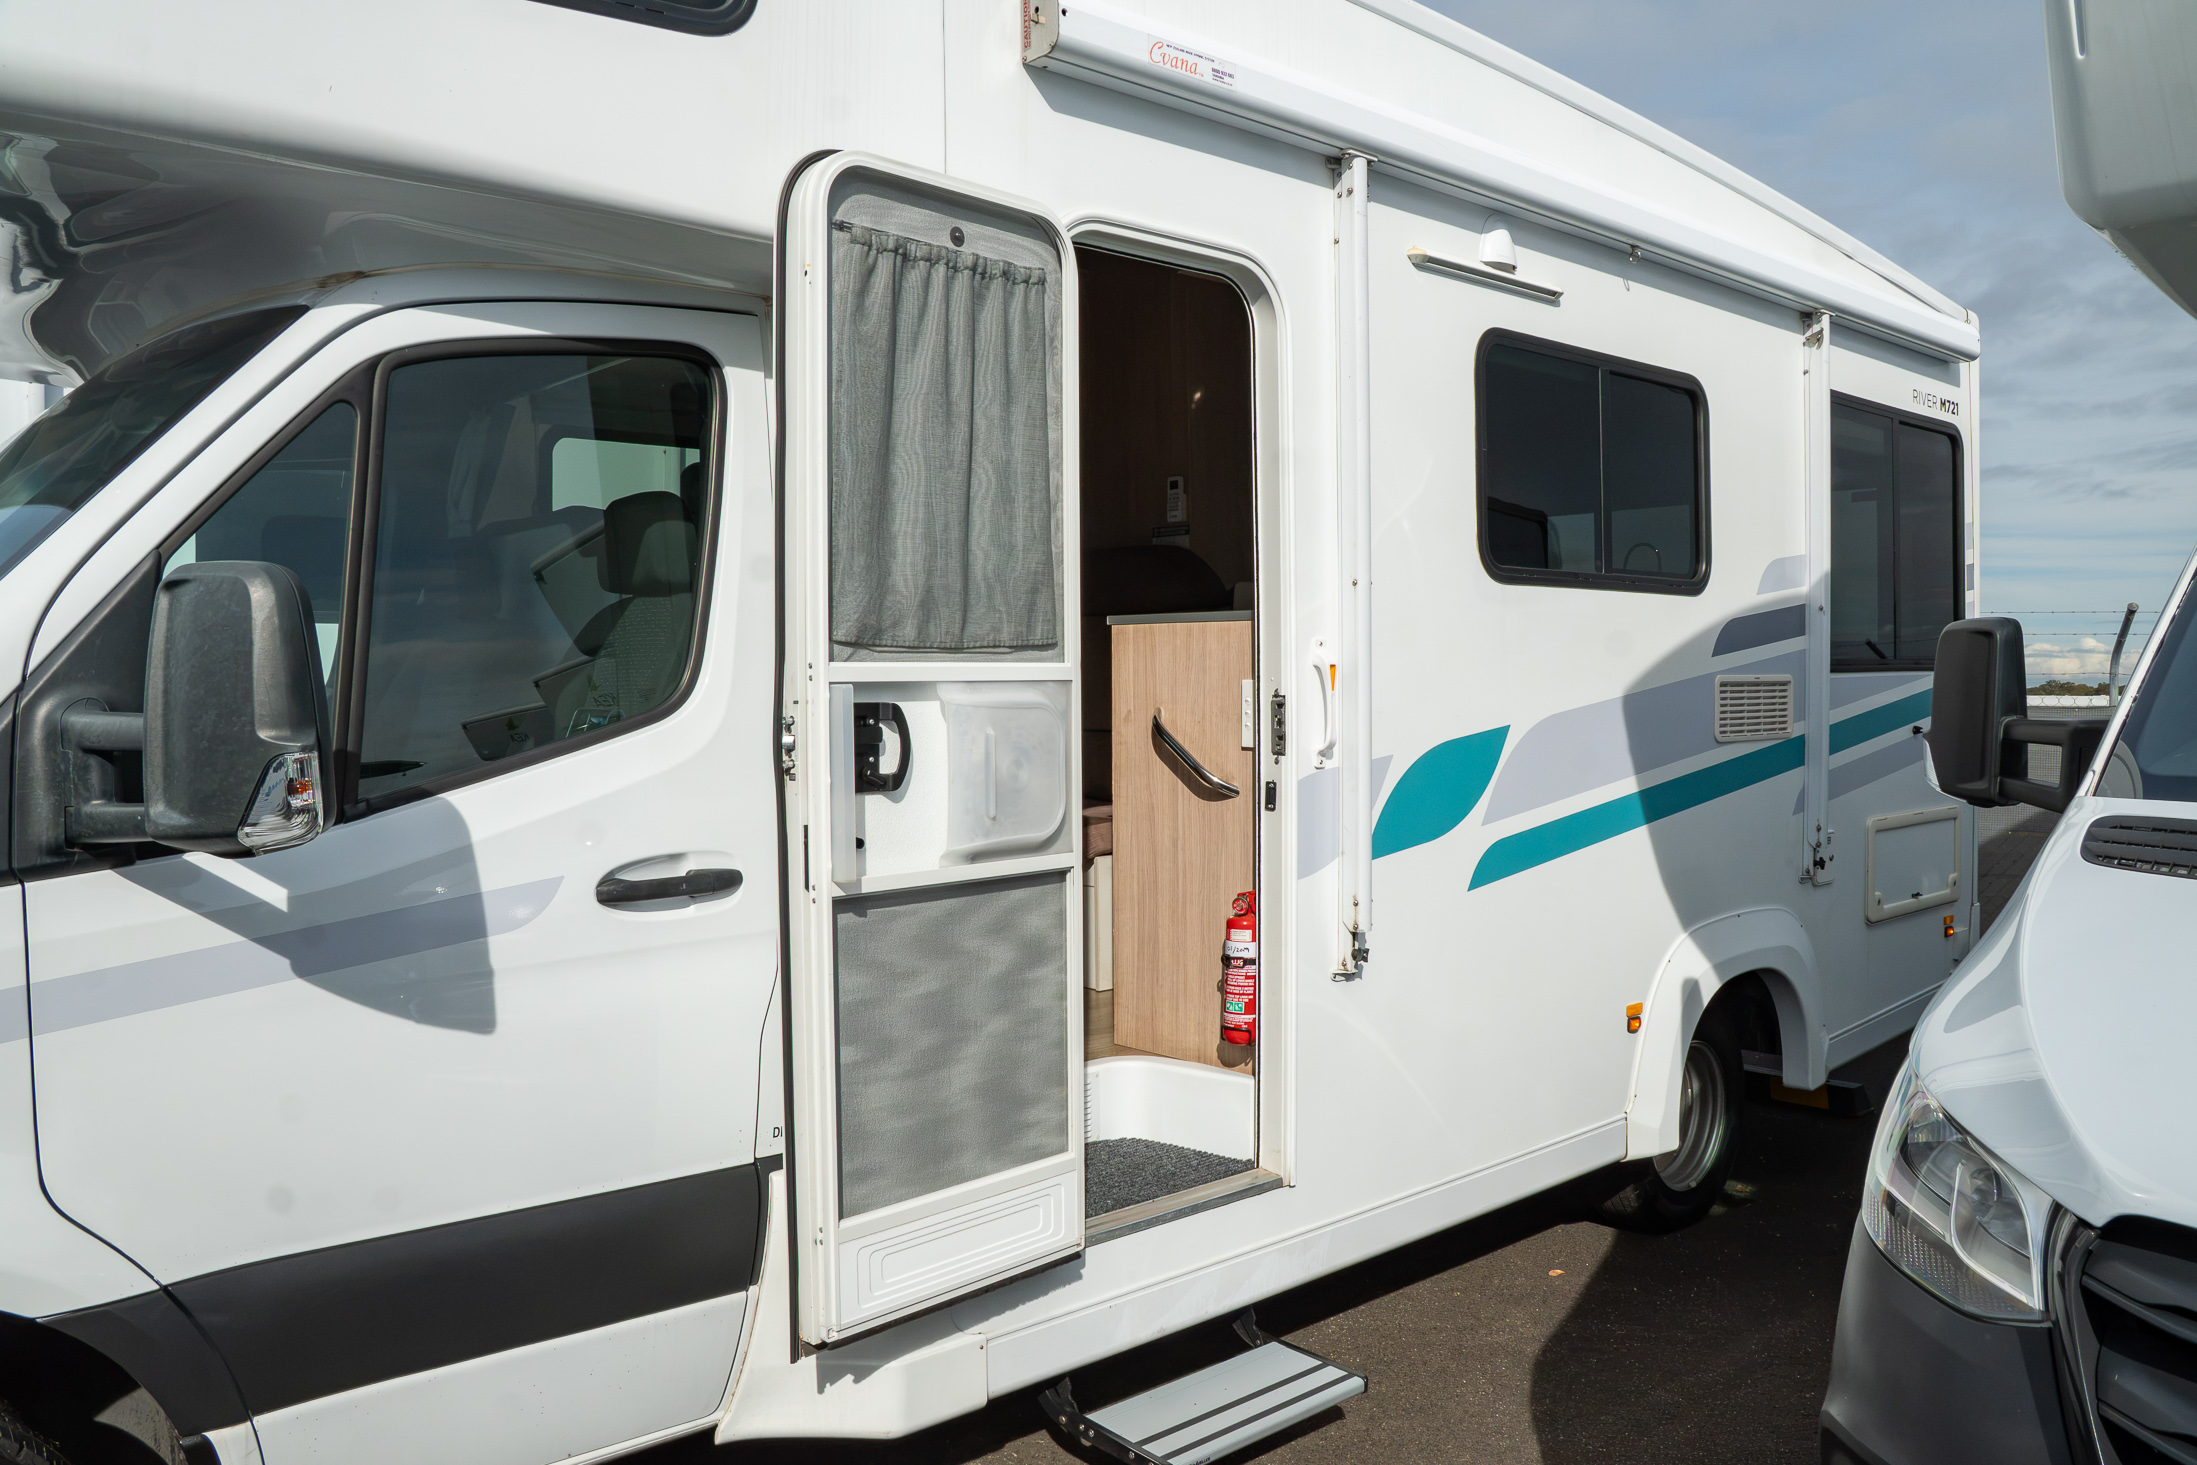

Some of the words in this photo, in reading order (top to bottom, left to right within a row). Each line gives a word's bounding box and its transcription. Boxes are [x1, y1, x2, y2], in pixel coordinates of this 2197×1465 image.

[1150, 41, 1199, 75] Cvana
[1912, 388, 1938, 410] RIVER
[1940, 397, 1959, 416] M721
